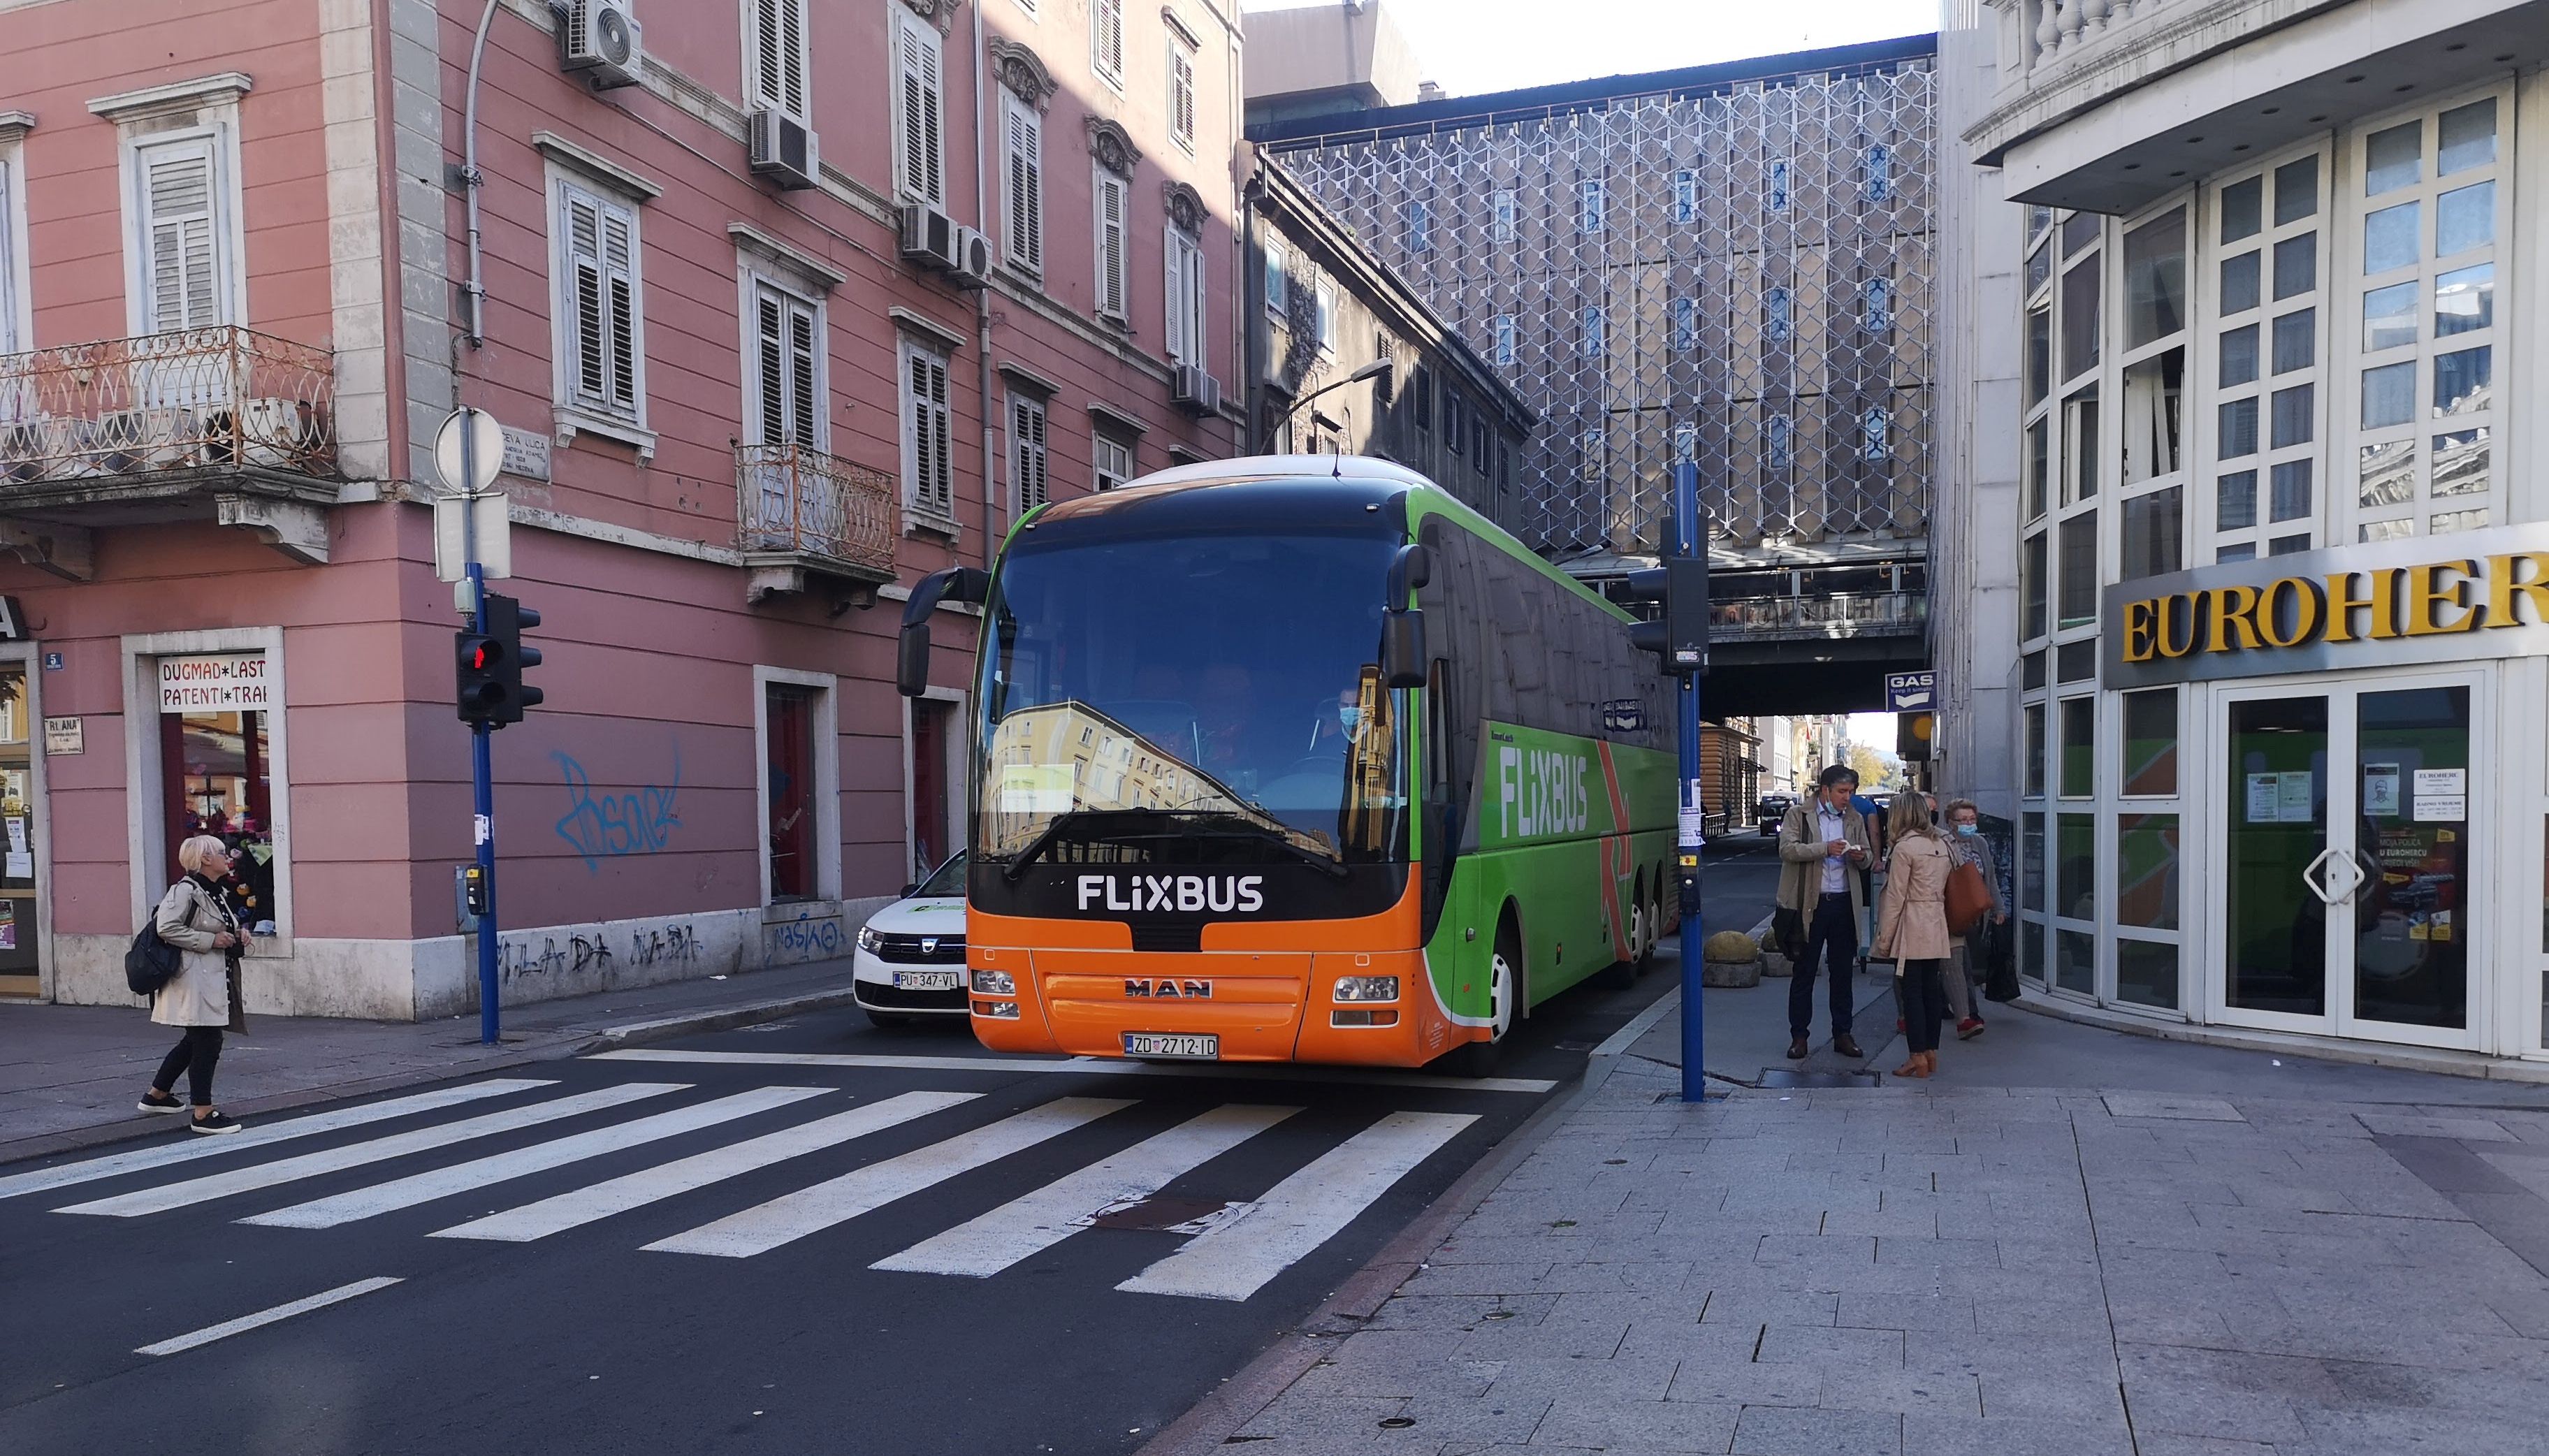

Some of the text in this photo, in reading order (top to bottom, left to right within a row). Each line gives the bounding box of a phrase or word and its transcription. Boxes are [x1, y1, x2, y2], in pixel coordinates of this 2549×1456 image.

[50, 654, 57, 665] 5
[1891, 675, 1933, 687] GAS
[901, 975, 913, 986] PU
[1124, 978, 1213, 999] MAN
[1134, 1038, 1152, 1053] ZD
